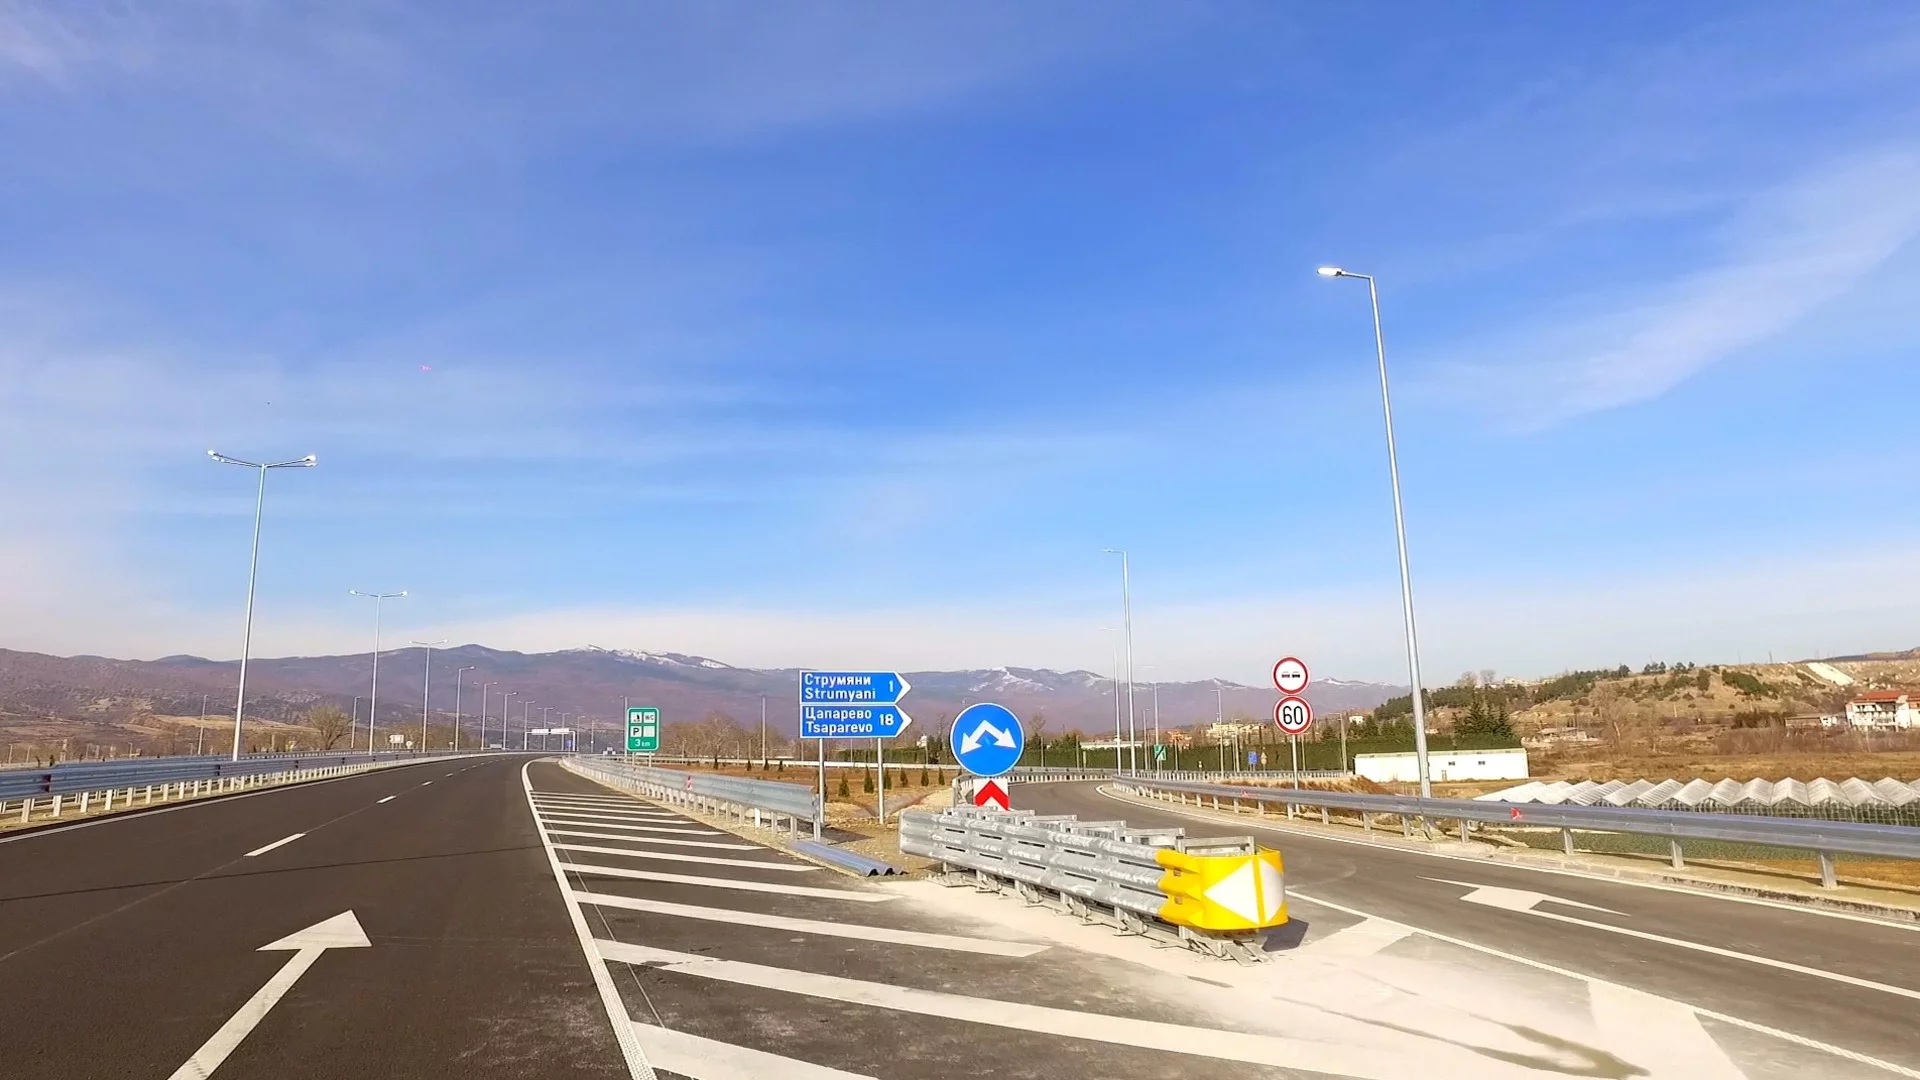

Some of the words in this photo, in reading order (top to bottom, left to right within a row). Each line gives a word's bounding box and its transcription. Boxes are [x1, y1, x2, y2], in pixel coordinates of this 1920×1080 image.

[804, 673, 871, 688] Струмяни
[888, 680, 894, 693] 1
[804, 687, 876, 702] Strumyani
[805, 707, 872, 722] Цапарево
[879, 713, 894, 726] 18
[1282, 705, 1304, 725] 60
[632, 727, 640, 736] P
[805, 721, 873, 736] Tsaparevo
[634, 738, 641, 747] 3
